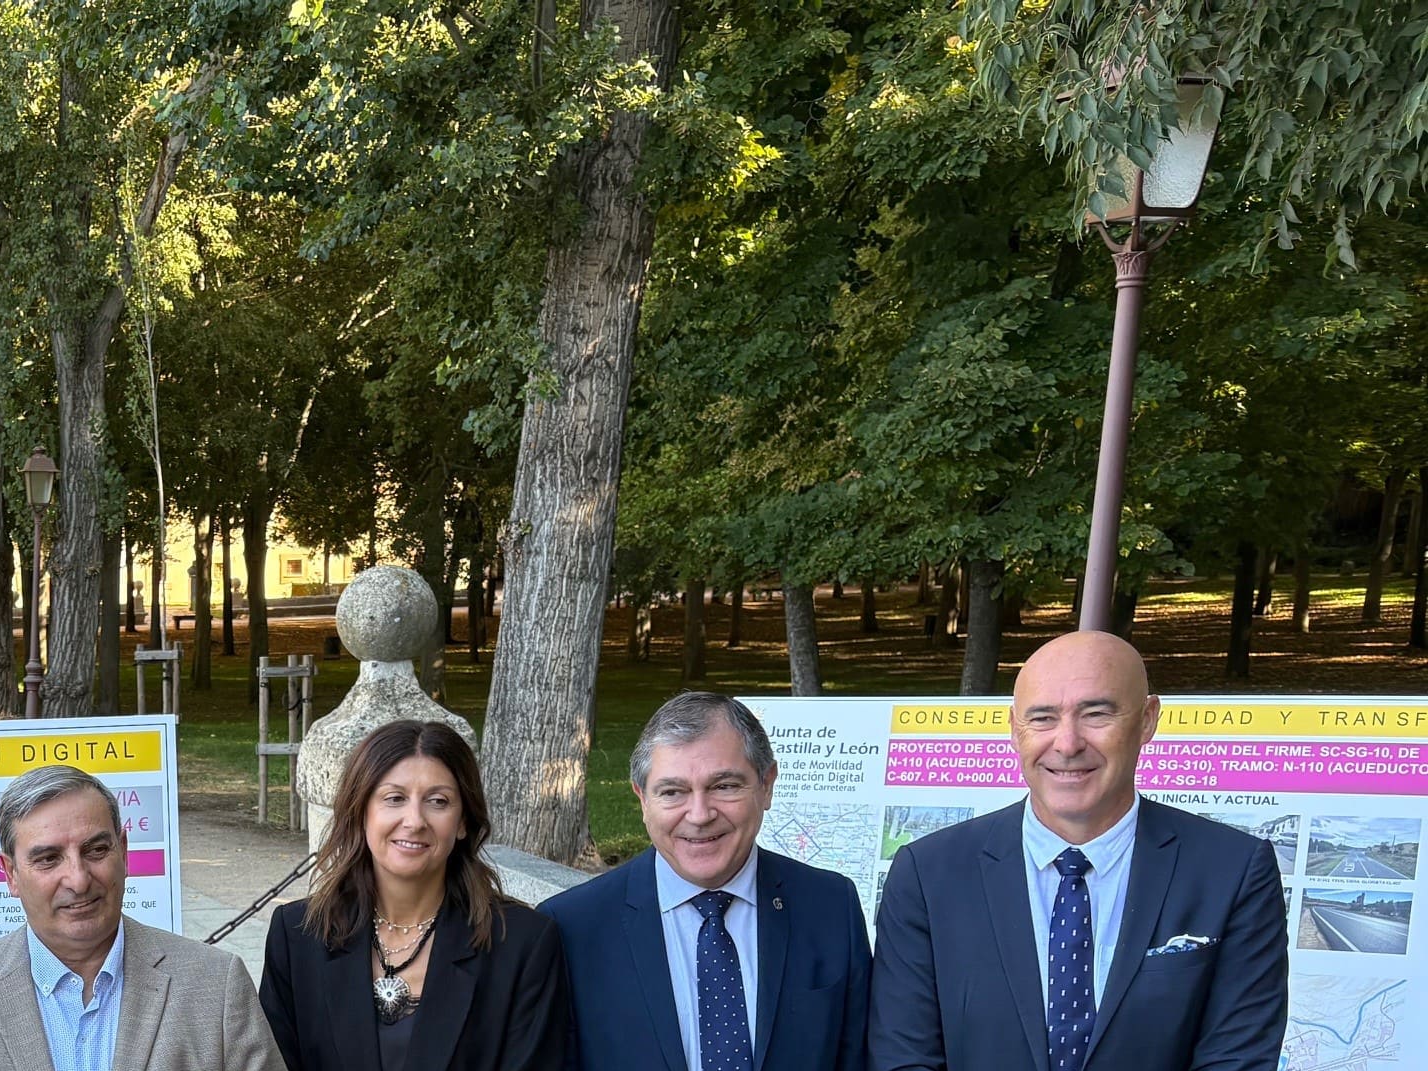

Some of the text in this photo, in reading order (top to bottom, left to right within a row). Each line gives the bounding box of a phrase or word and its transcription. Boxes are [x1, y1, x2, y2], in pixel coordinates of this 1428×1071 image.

[899, 711, 1010, 724] CONSEJE
[1279, 711, 1292, 724] Y
[769, 725, 836, 738] Junta de
[22, 741, 135, 762] DIGITAL
[825, 745, 835, 757] y
[839, 742, 879, 754] León
[889, 742, 960, 754] PROYECTO
[964, 743, 983, 754] DE
[1232, 745, 1261, 757] DEL
[1265, 746, 1315, 757] FIRME.
[1320, 746, 1393, 760] SC-SG-10,
[1398, 747, 1420, 759] DE
[792, 760, 806, 769] de
[809, 760, 862, 771] Movilidad
[888, 758, 922, 768] N-110
[926, 757, 1018, 771] (ACUEDUCTO)
[1157, 760, 1215, 773] SG-310).
[1220, 761, 1278, 772] TRAMO:
[1283, 762, 1323, 773] N-110
[828, 772, 864, 784] Digital
[887, 772, 924, 782] C-607.
[928, 773, 953, 783] P.K.
[957, 773, 993, 783] 0+000
[996, 773, 1015, 783] AL
[1150, 775, 1218, 786] 4.7-SG-18
[1162, 794, 1209, 804] INICIAL
[1213, 795, 1222, 804] Y
[1224, 795, 1279, 806] ACTUAL
[142, 900, 157, 909] QUE
